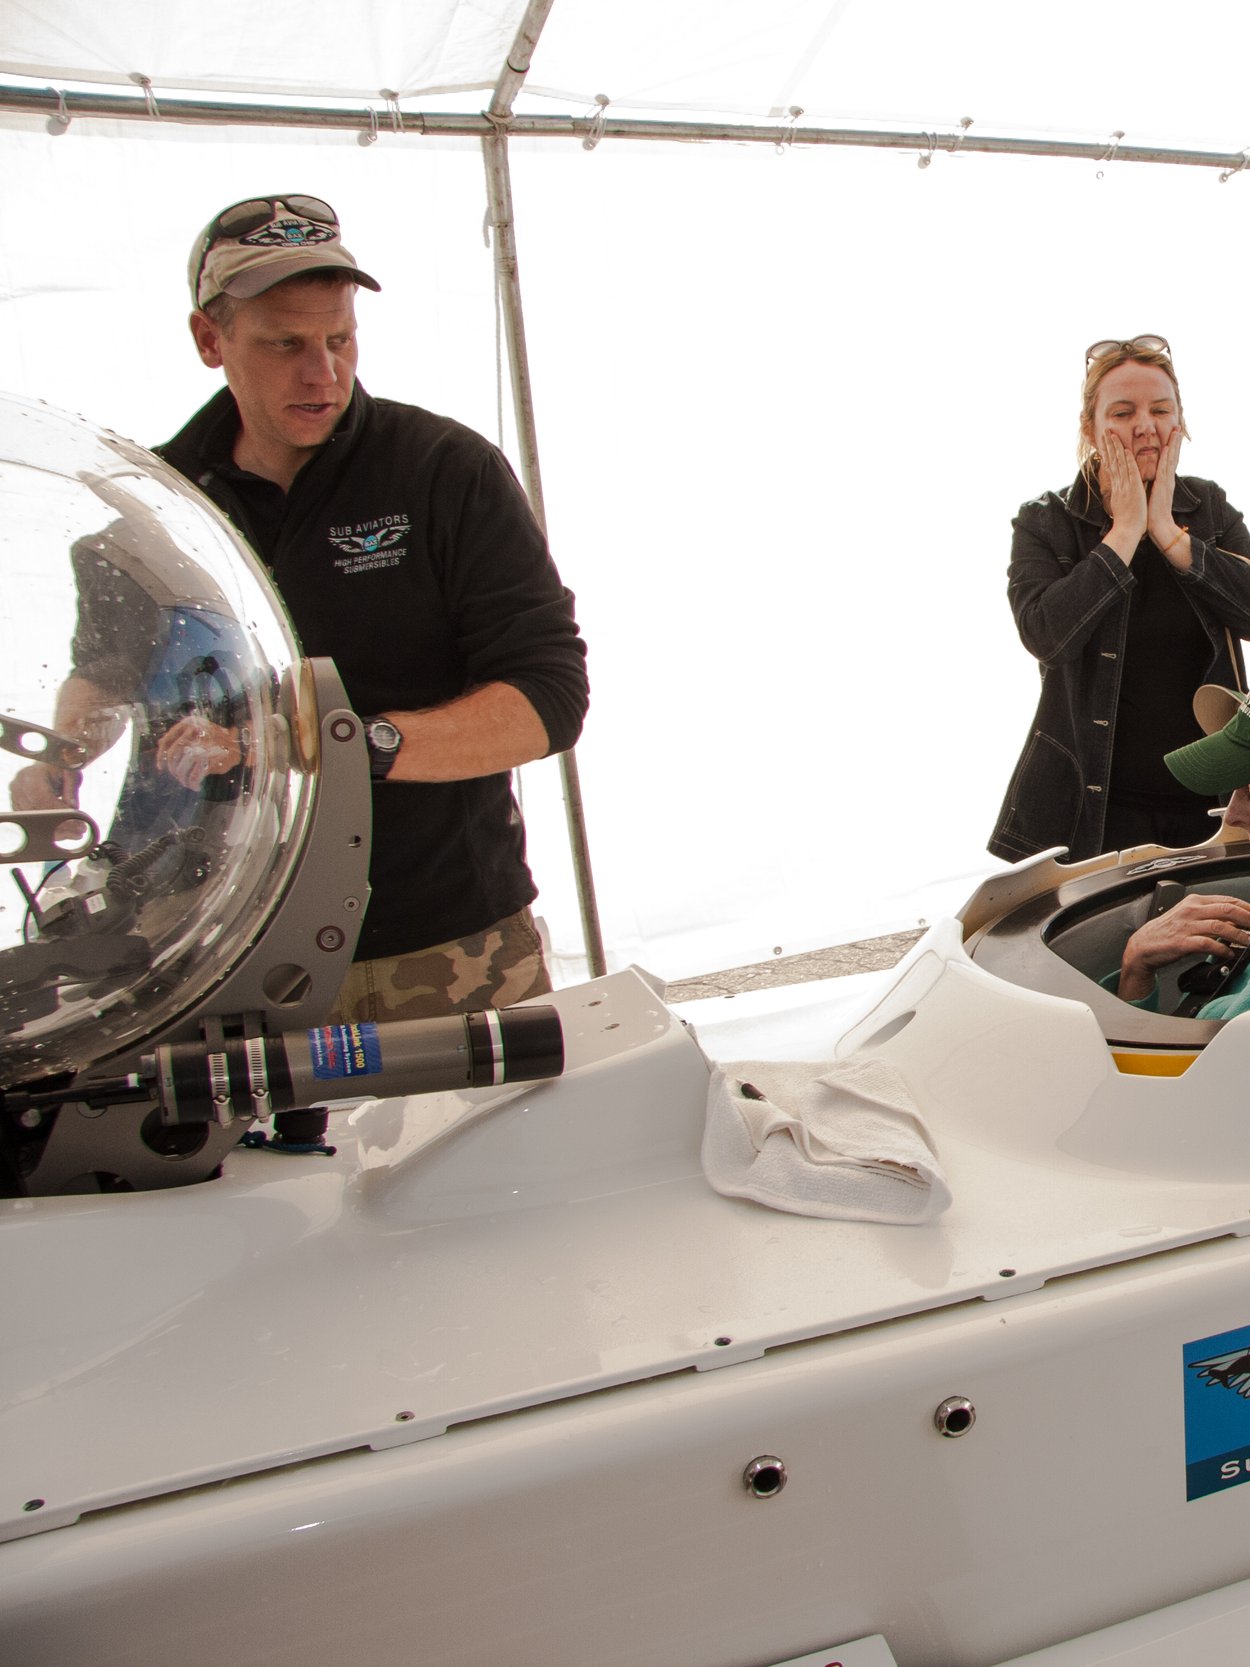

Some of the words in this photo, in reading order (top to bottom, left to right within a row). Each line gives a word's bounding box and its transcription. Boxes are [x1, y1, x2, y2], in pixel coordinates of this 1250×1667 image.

[330, 526, 352, 537] SUB
[356, 514, 409, 534] AVIATORS
[334, 558, 352, 568] HIGH
[353, 548, 407, 565] PERFORMANCE
[343, 557, 400, 574] SUBMERSIBLES
[354, 1049, 366, 1069] 1500
